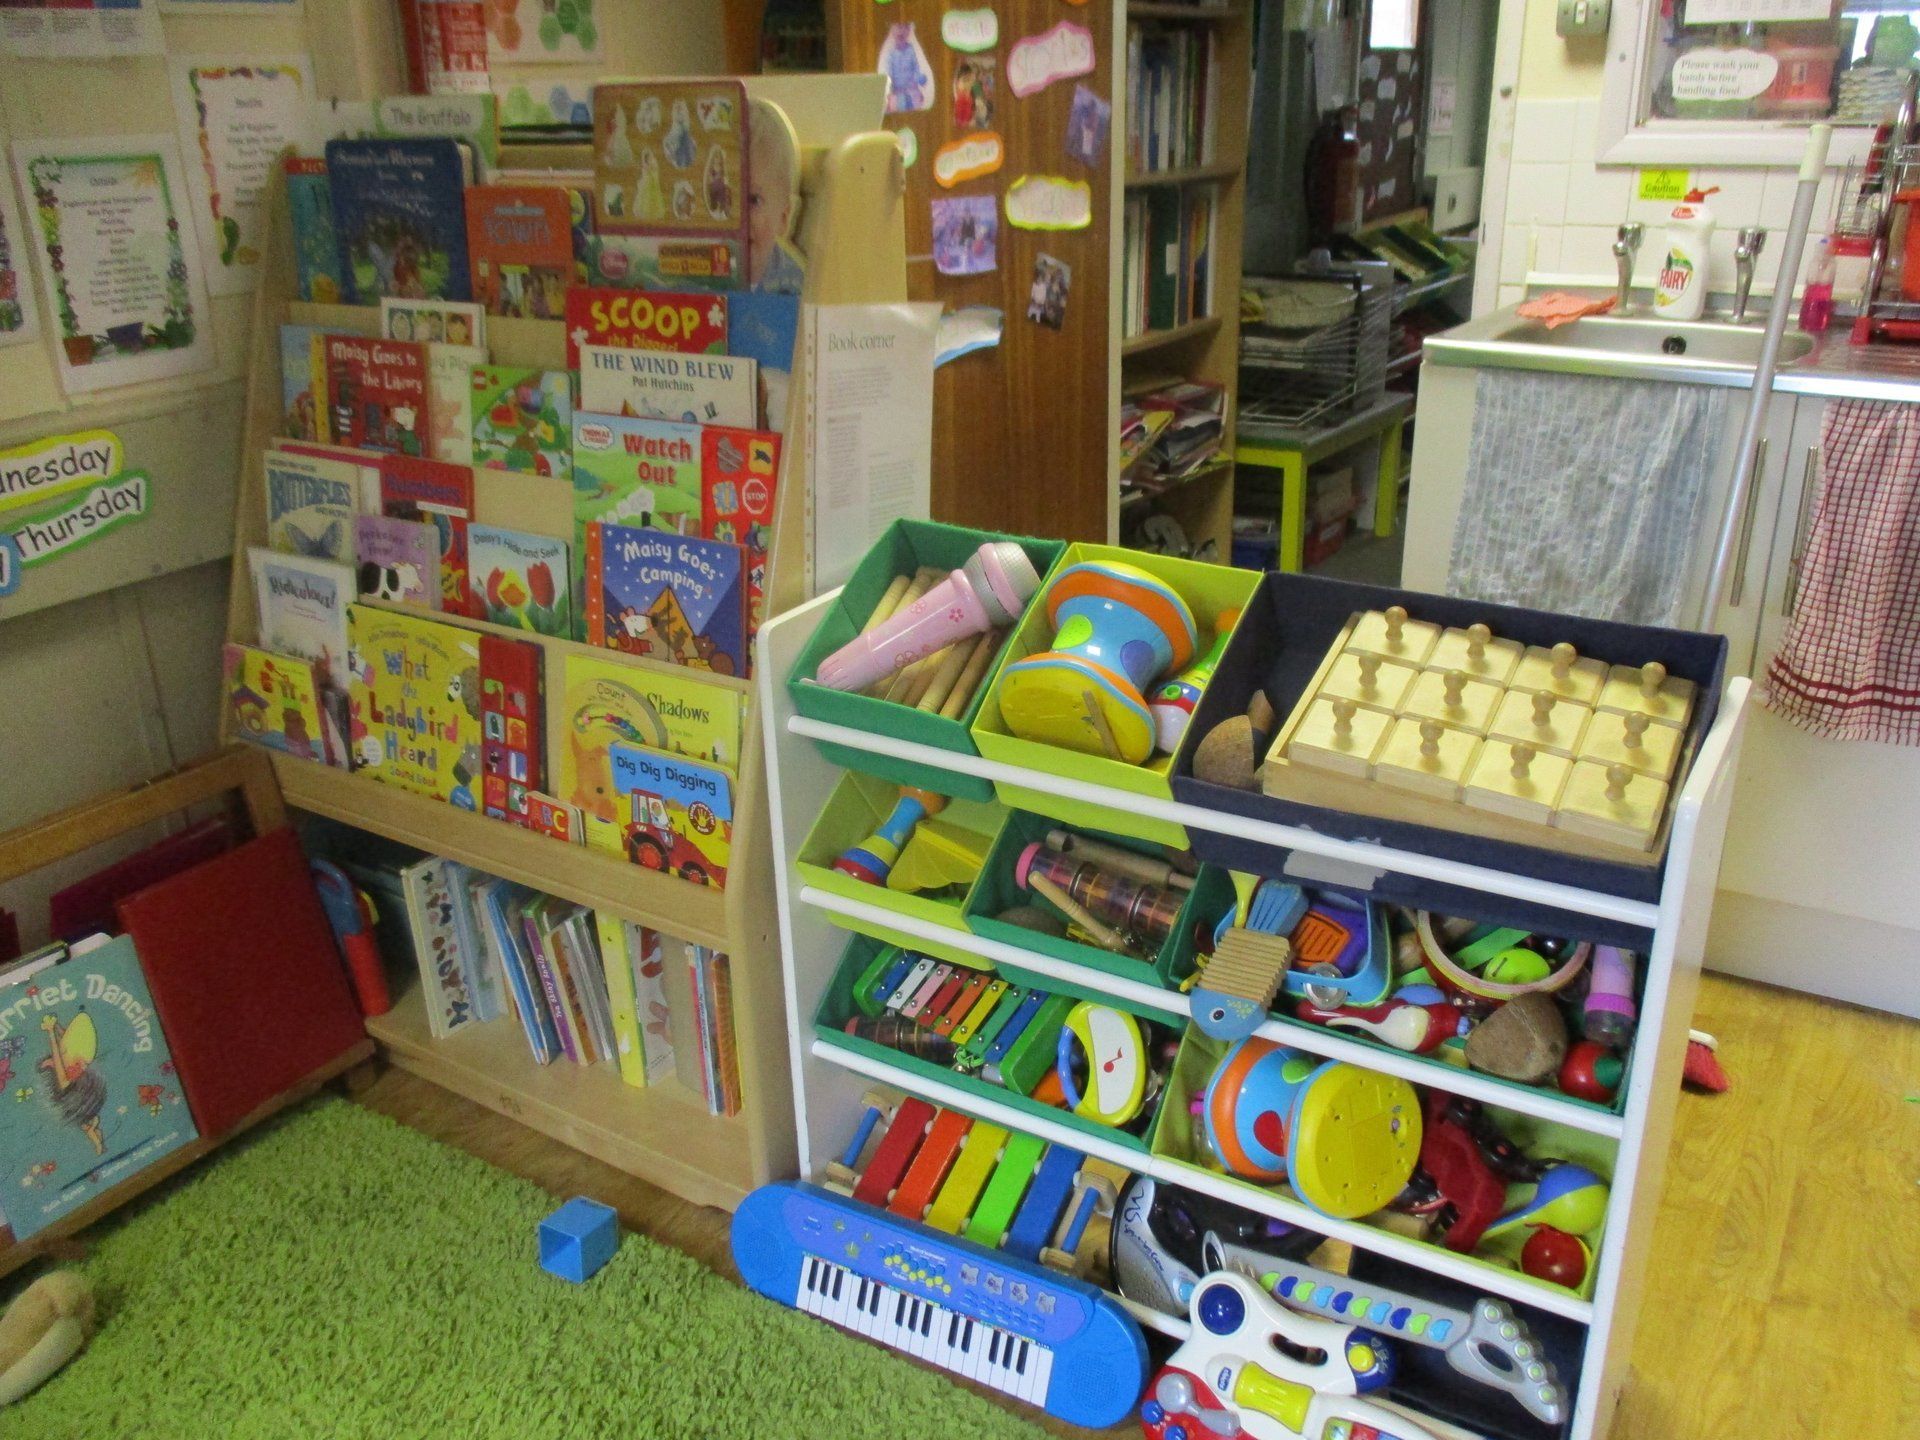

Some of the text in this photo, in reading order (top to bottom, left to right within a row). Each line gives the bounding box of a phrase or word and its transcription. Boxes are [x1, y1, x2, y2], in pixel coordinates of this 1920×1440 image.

[1681, 59, 1759, 71] Please wash your
[390, 107, 414, 126] The
[1645, 183, 1680, 193] Caution
[1660, 268, 1689, 291] FAIRY
[591, 297, 700, 339] SCOOP
[332, 342, 369, 367] Maisy
[372, 345, 404, 366] Goes
[407, 350, 418, 367] to
[828, 332, 896, 352] Book corner
[591, 352, 734, 381] THE WIND BLEW
[362, 373, 423, 394] the Library
[632, 375, 695, 392] Pat Hutchins
[622, 433, 693, 462] Watch
[637, 461, 677, 486] Out
[747, 491, 766, 501] STOP
[12, 482, 142, 558] Thursday
[623, 541, 717, 580] Maisy Goes
[640, 566, 704, 600] Camping
[383, 646, 430, 681] What
[401, 684, 417, 699] the
[596, 682, 626, 701] Count
[369, 691, 460, 744] Ladybird
[646, 692, 710, 724] Shadows
[385, 730, 438, 772] Heard
[616, 756, 717, 796] Dig Dig Digging
[85, 973, 153, 1054] Dancing
